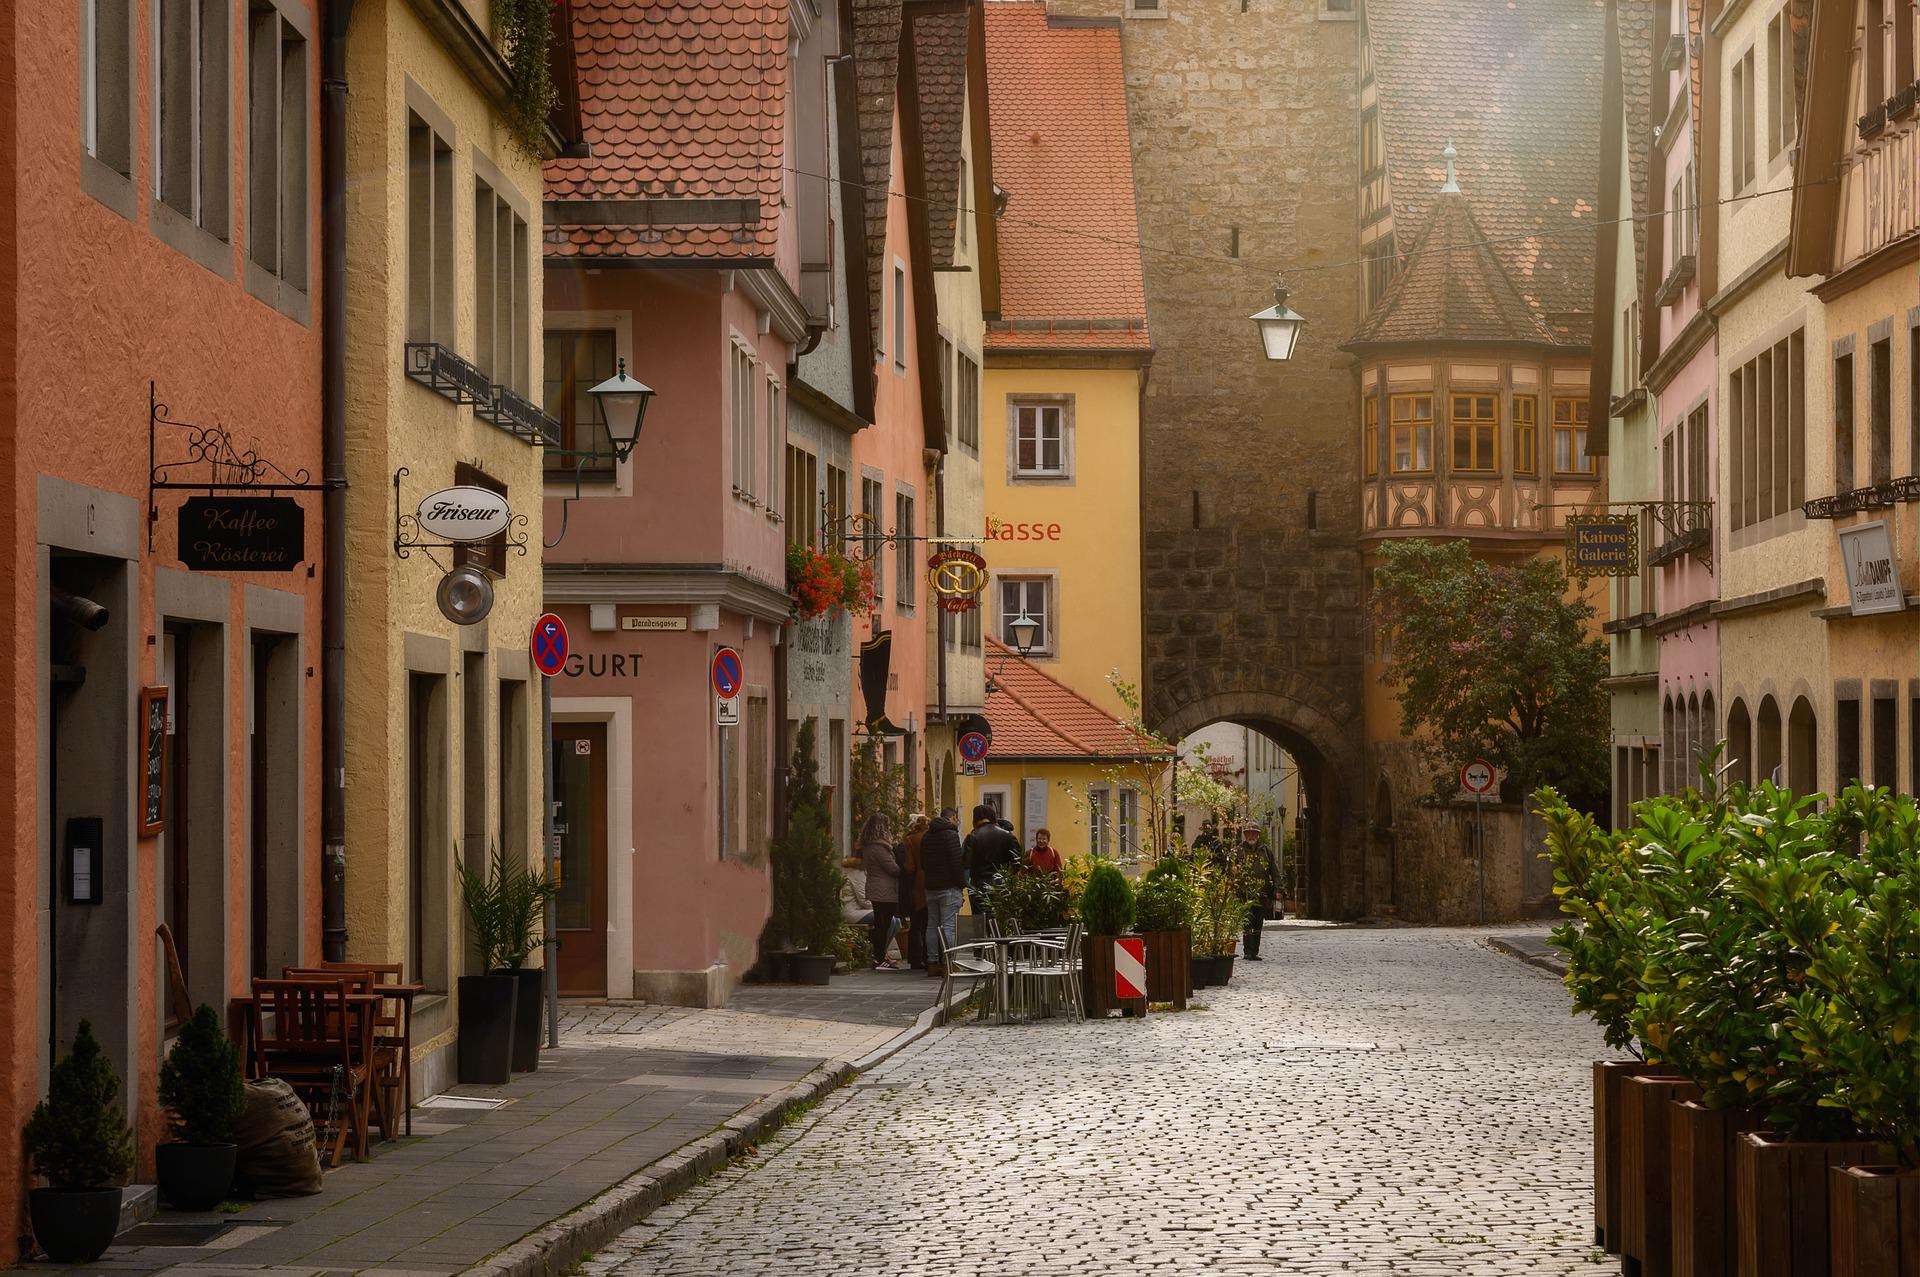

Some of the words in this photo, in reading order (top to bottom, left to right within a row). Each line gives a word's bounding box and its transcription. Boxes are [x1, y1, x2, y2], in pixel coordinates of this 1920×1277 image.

[427, 501, 499, 520] Friseur
[203, 508, 278, 536] Kaffee
[1579, 530, 1626, 544] Kairos
[193, 541, 287, 562] Rösterei
[940, 551, 977, 561] Bäckerei
[1579, 547, 1626, 561] Galerie
